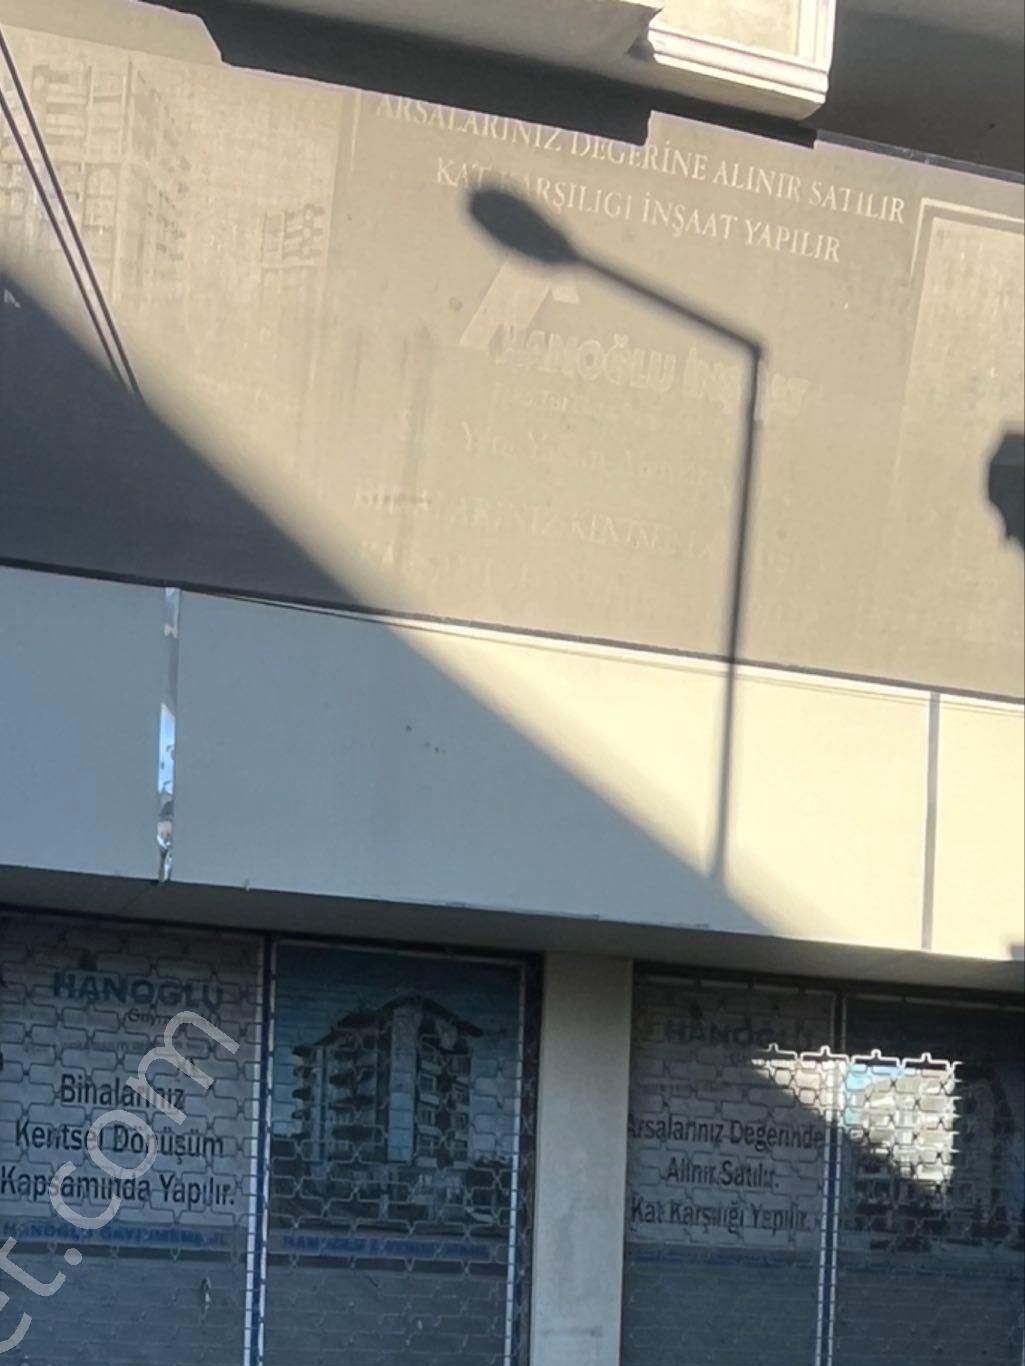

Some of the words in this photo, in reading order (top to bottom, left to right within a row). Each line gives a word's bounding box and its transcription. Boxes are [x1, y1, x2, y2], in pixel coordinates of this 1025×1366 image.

[712, 159, 802, 203] ALINIR
[808, 180, 906, 225] SATILIR
[641, 191, 738, 240] İNŞAAT
[744, 218, 841, 264] YAPILIR
[15, 1119, 103, 1151] Kentsel
[0, 1165, 151, 1201] Kapsamında
